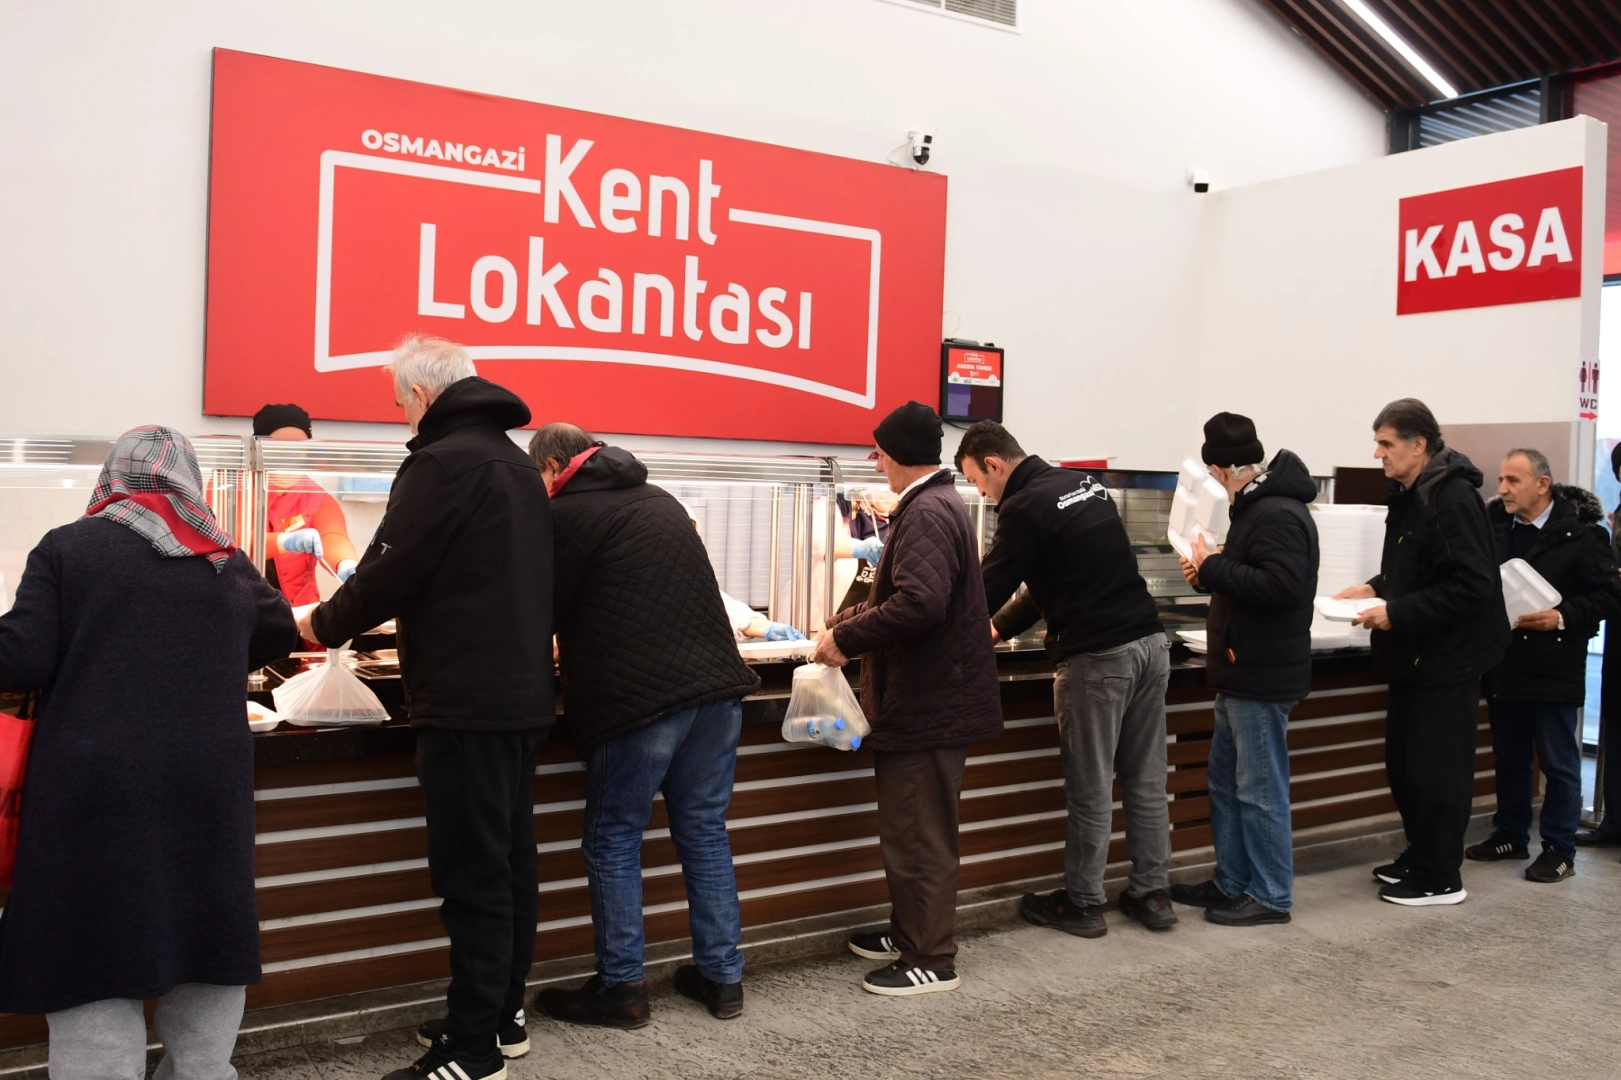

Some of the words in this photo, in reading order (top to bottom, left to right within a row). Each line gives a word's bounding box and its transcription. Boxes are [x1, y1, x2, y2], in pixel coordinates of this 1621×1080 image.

[543, 133, 722, 246] Kent
[417, 222, 813, 350] Lokantası
[1404, 206, 1573, 282] KASA
[1579, 397, 1597, 410] WC
